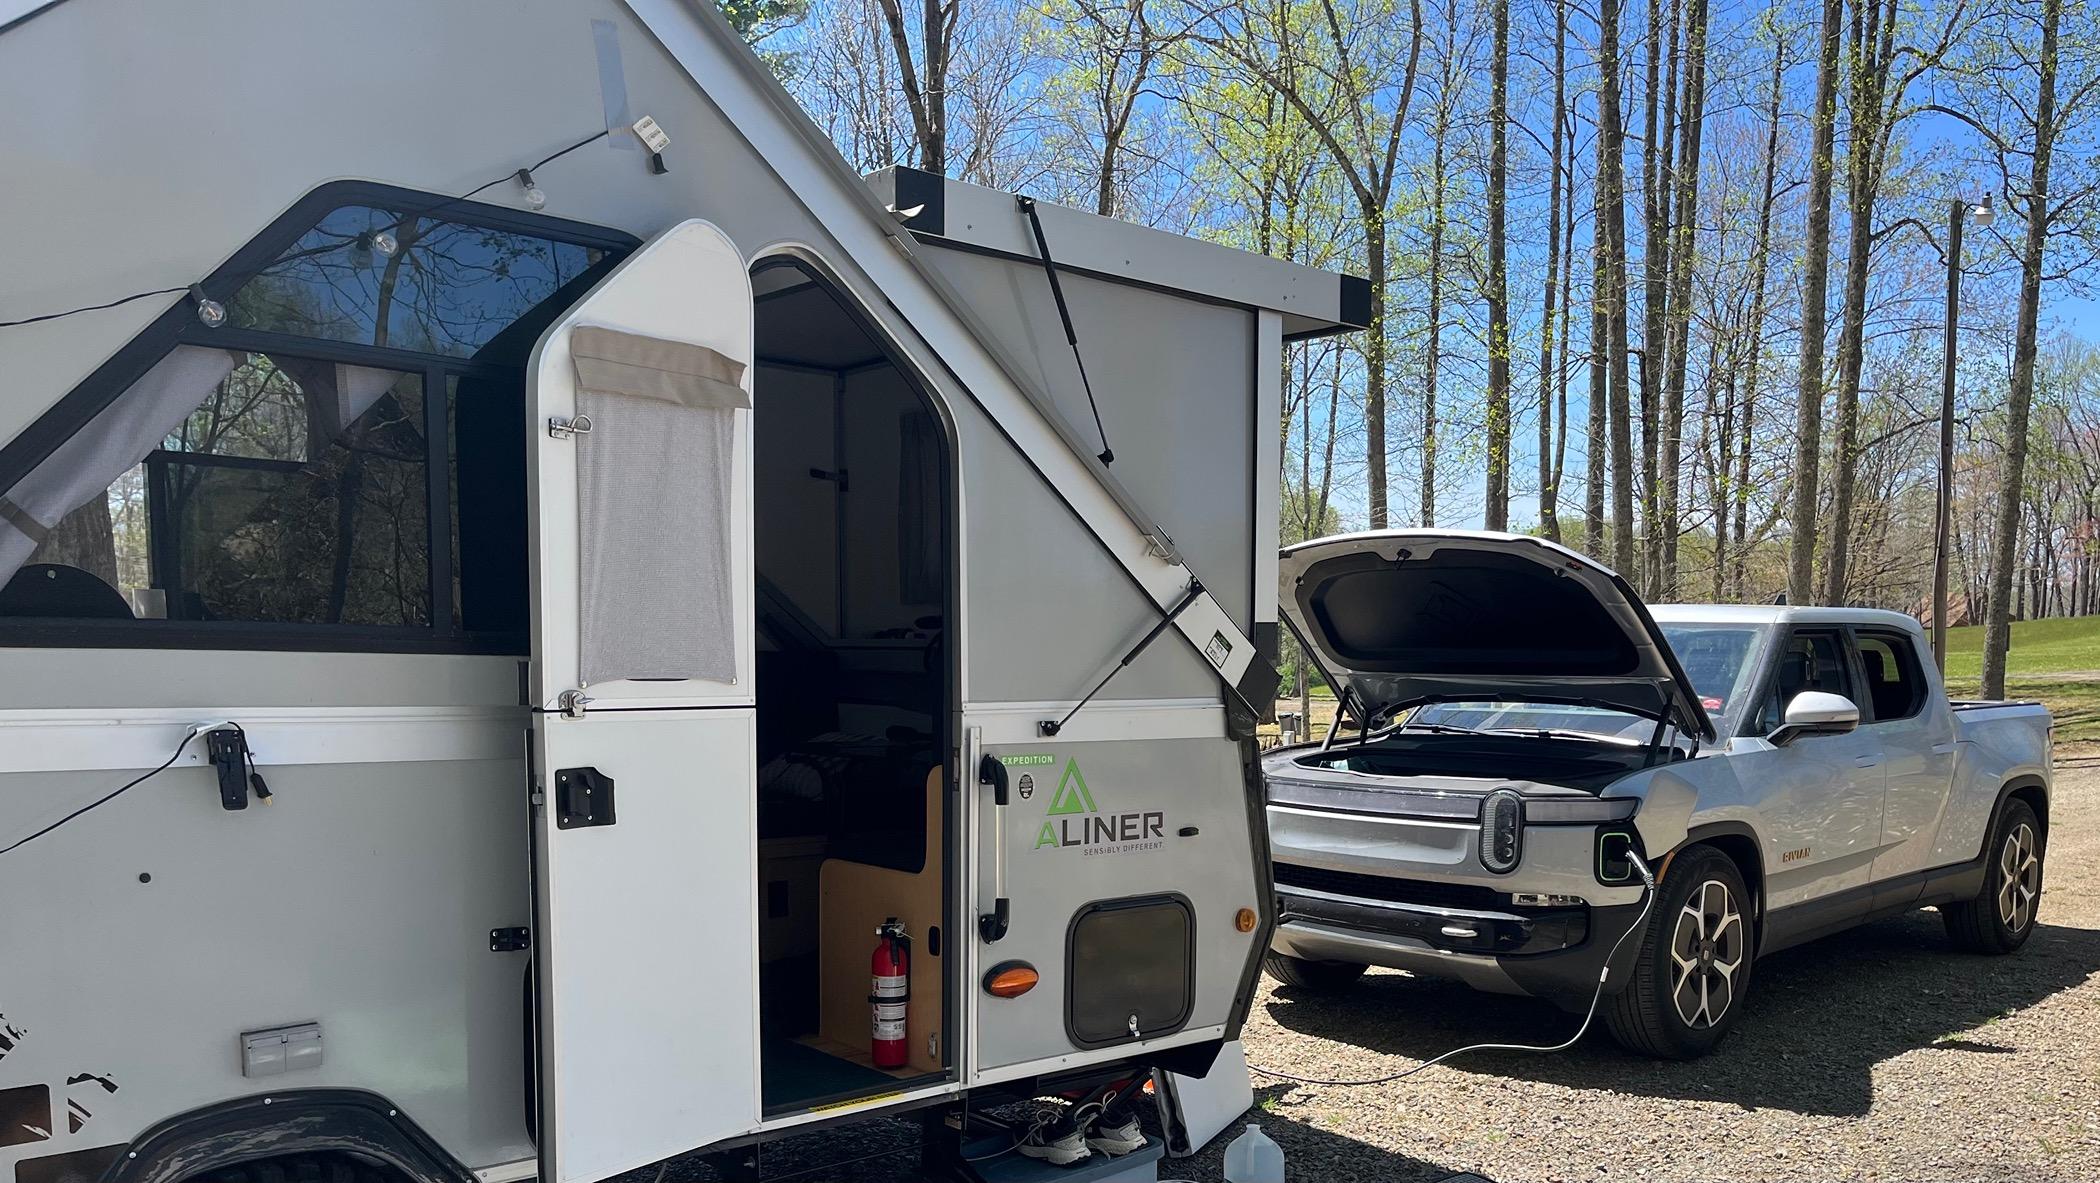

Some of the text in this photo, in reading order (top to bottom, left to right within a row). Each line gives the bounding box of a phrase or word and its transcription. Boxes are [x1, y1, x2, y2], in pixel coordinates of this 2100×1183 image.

[1002, 755, 1053, 766] EXPEDITION
[1035, 811, 1165, 850] ALINER
[1083, 841, 1163, 856] SENSIBLY DIFFERENT
[1782, 847, 1811, 863] RIVIAN
